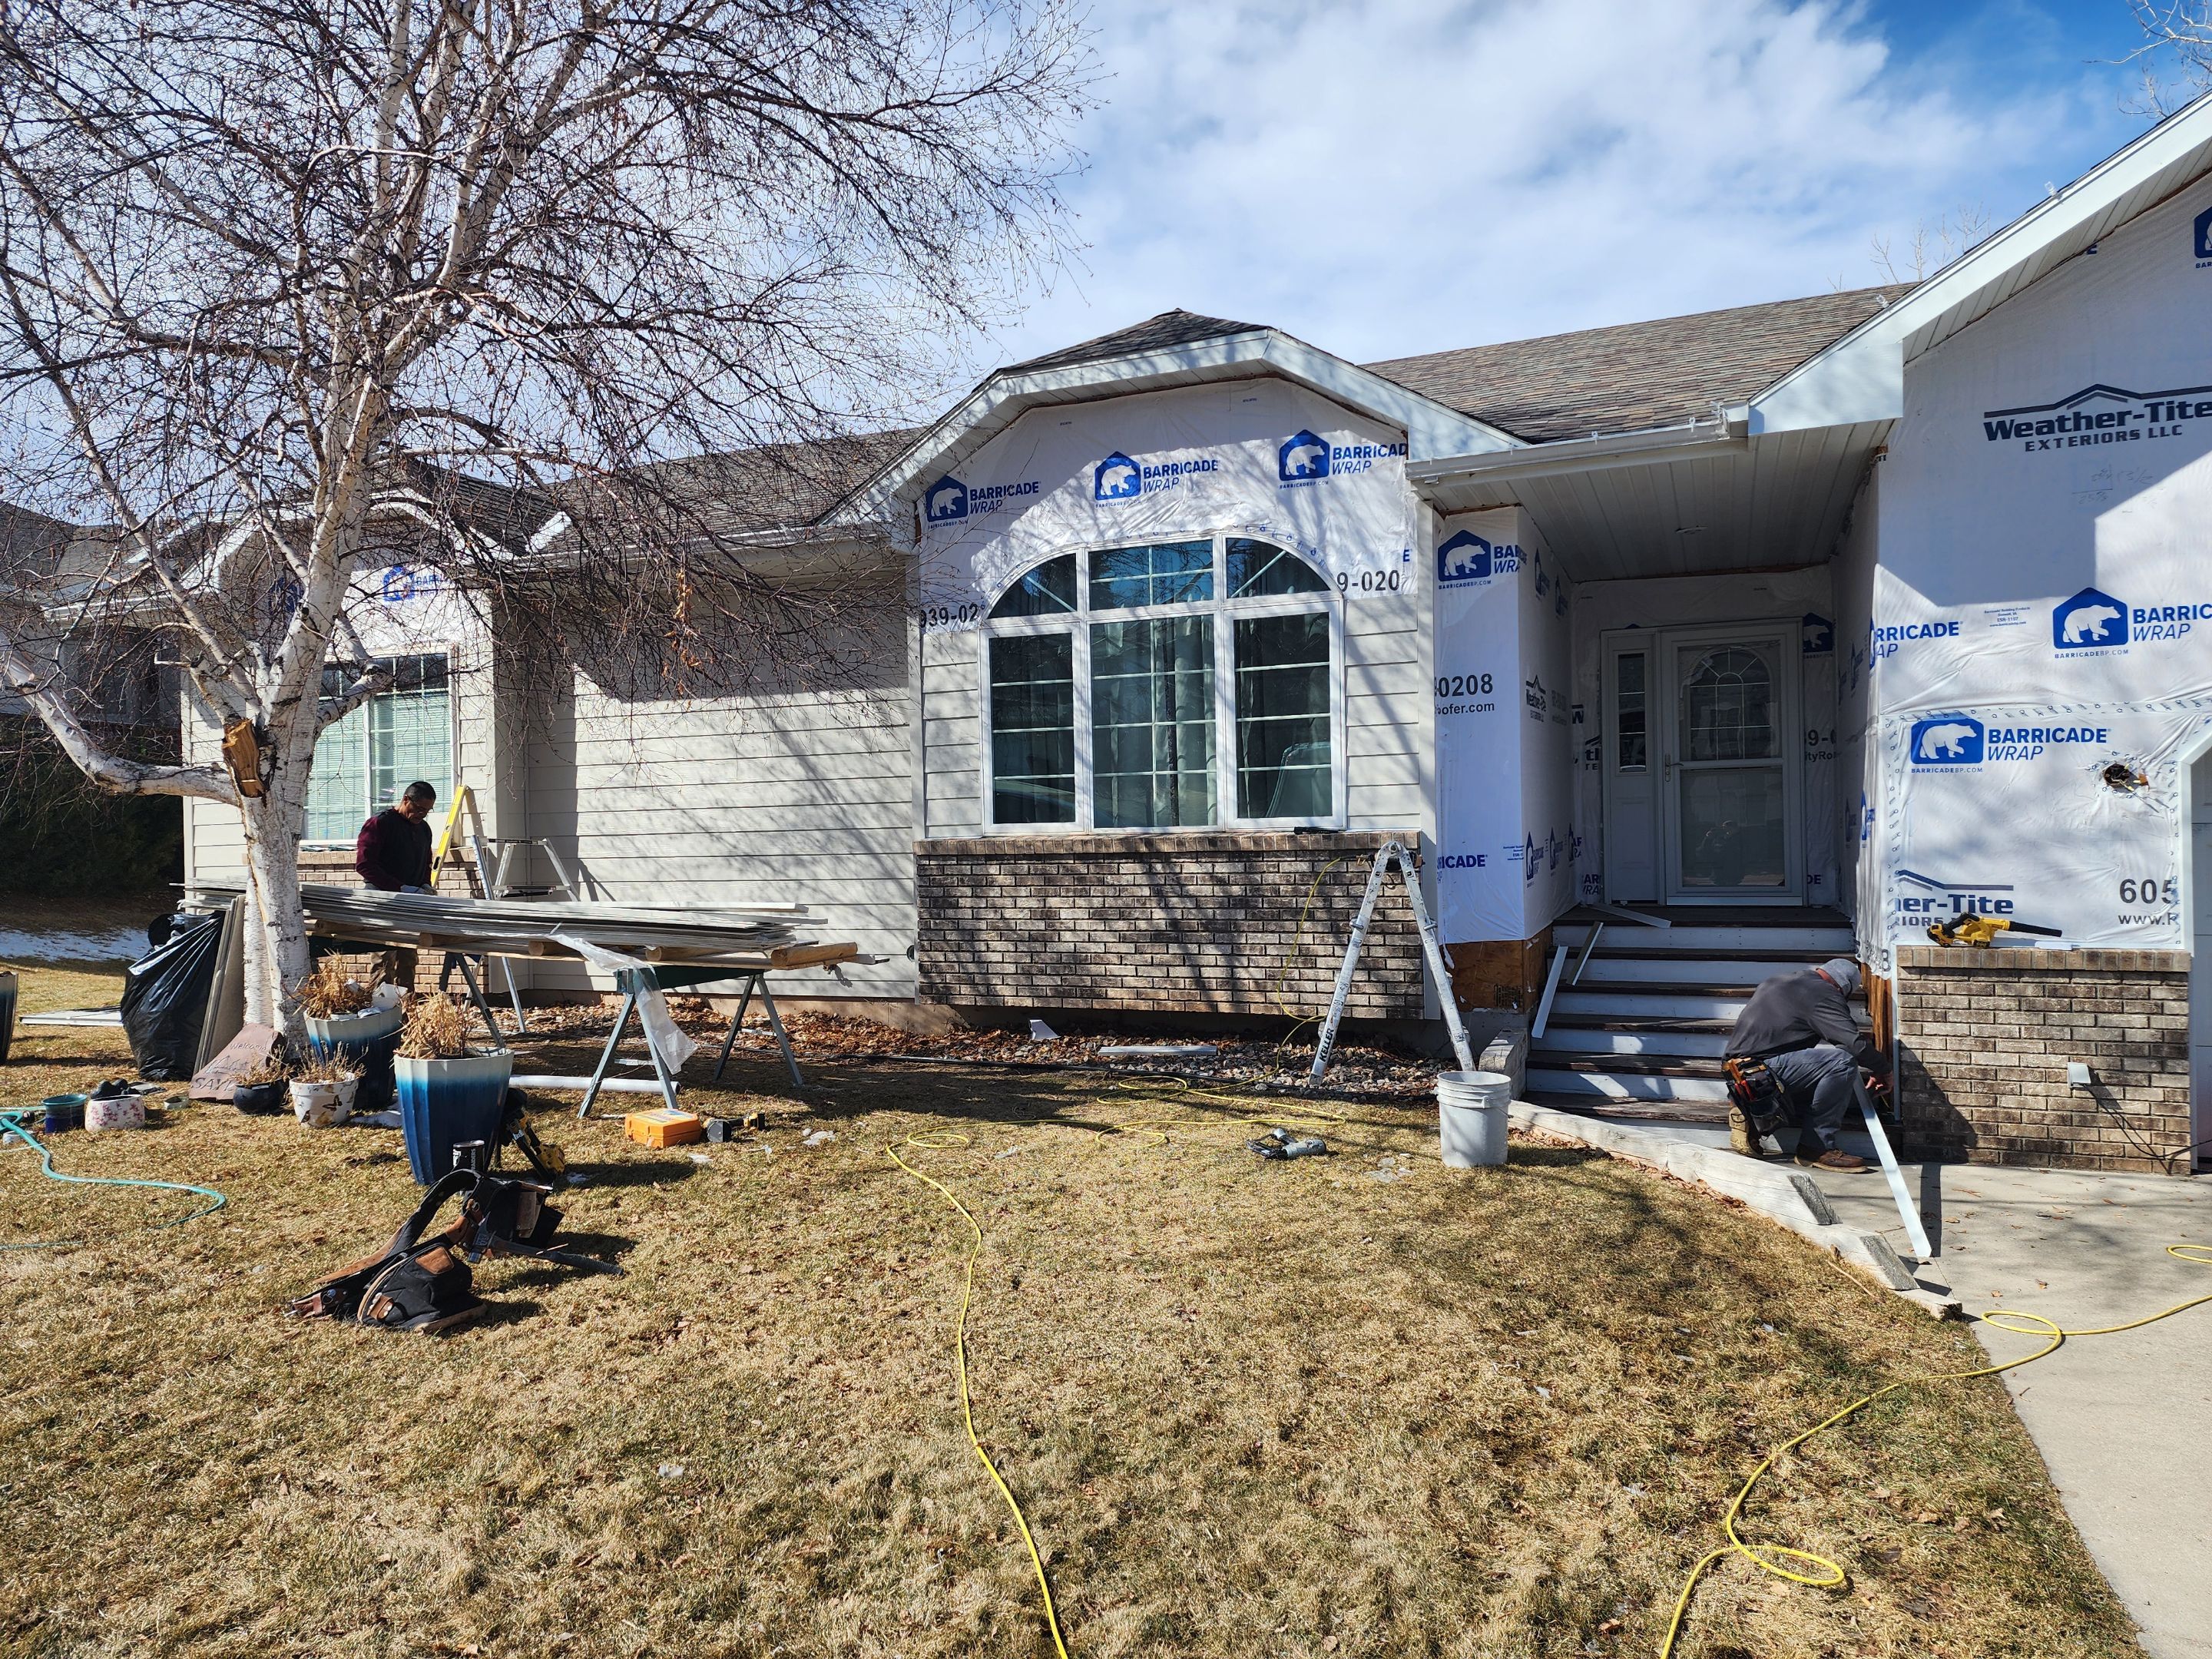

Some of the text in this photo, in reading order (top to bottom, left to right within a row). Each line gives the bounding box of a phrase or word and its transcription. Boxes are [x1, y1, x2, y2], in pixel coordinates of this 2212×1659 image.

[1983, 400, 2212, 442] Weather-Tite
[2025, 424, 2183, 452] EXTERIORS LLC
[1144, 459, 1218, 479] BARRICADE
[1333, 460, 1372, 475] WRAP
[969, 481, 1039, 502] BARRICADE
[1144, 477, 1180, 494] WRAP
[970, 500, 1003, 515] WRAP
[1336, 569, 1400, 592] 9-020
[1438, 580, 1492, 590] BARRICADEBP.COM
[2133, 623, 2190, 643] WRAP
[2055, 649, 2129, 659] BARRICADEBP.COM
[1988, 727, 2108, 745] BARRICADE
[1988, 745, 2044, 762] WRAP
[1438, 854, 1486, 869] ICADE
[1319, 1028, 1335, 1062] KELLER
